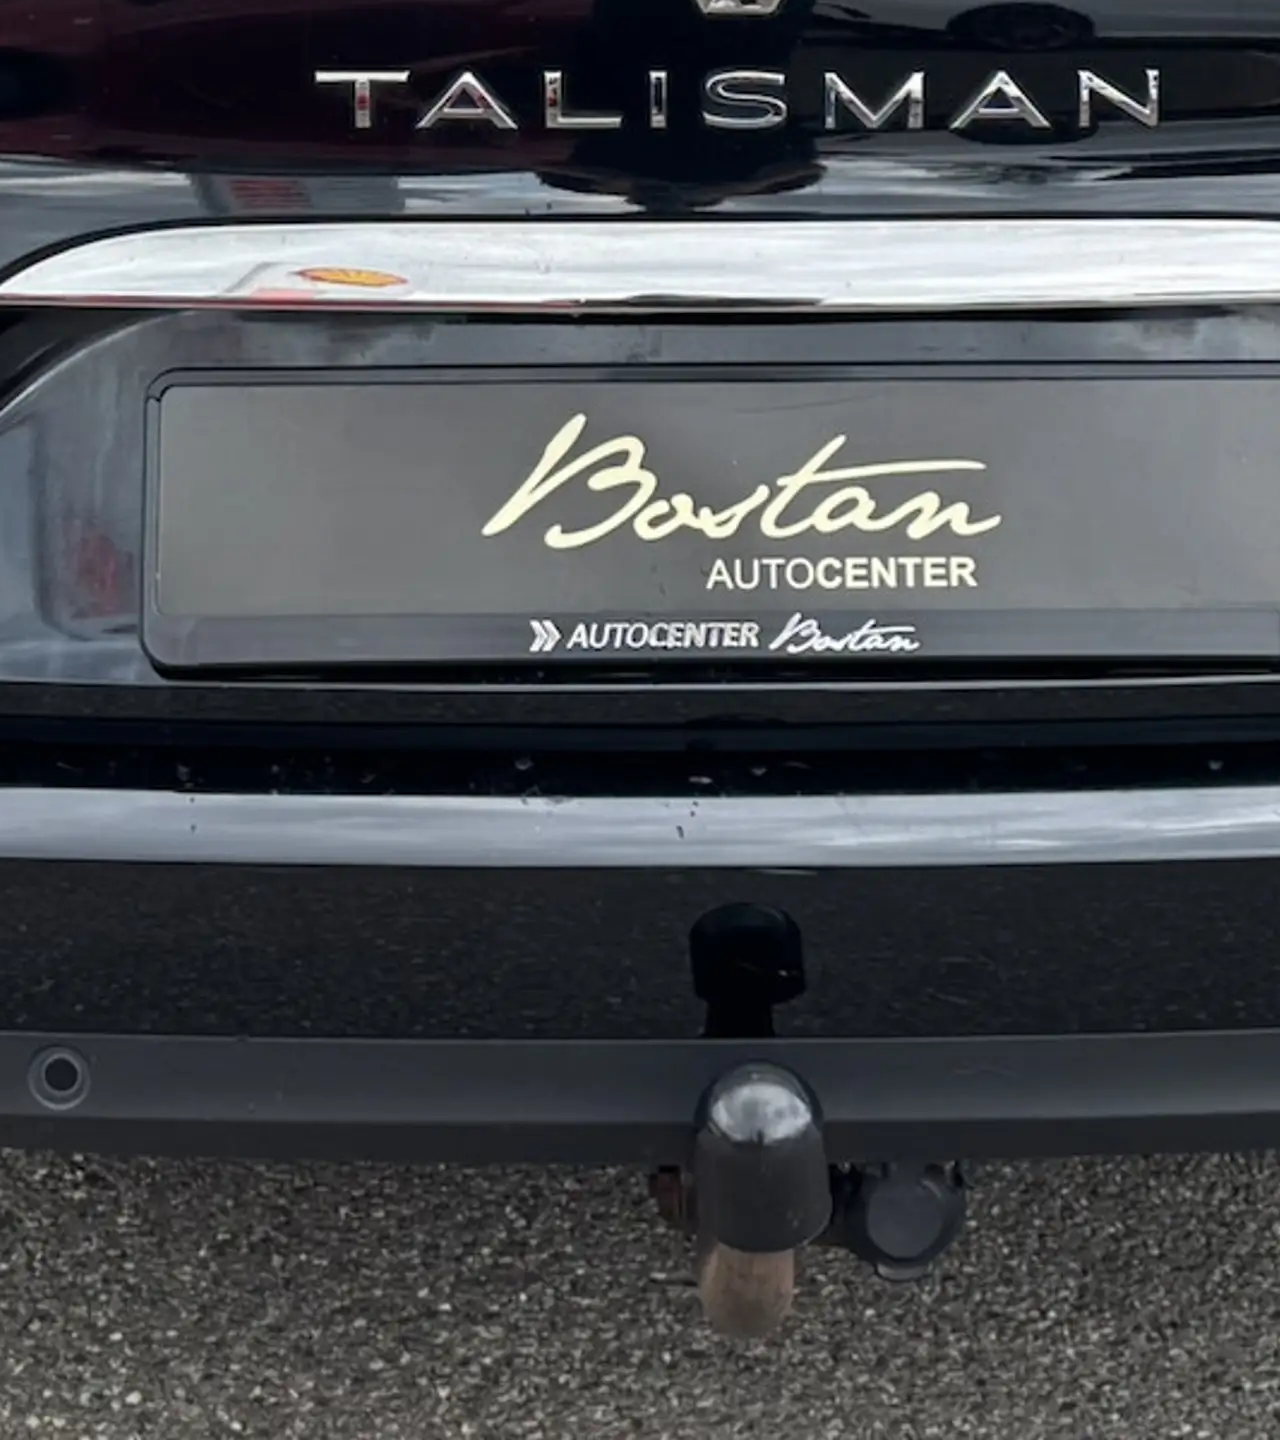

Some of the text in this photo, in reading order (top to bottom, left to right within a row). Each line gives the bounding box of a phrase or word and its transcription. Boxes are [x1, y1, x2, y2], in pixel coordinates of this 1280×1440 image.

[315, 68, 1161, 130] TALISMAN
[481, 413, 1001, 549] Bostan
[705, 556, 978, 590] AUTOCENTER
[566, 612, 920, 654] AUTOCENTER Bostan
